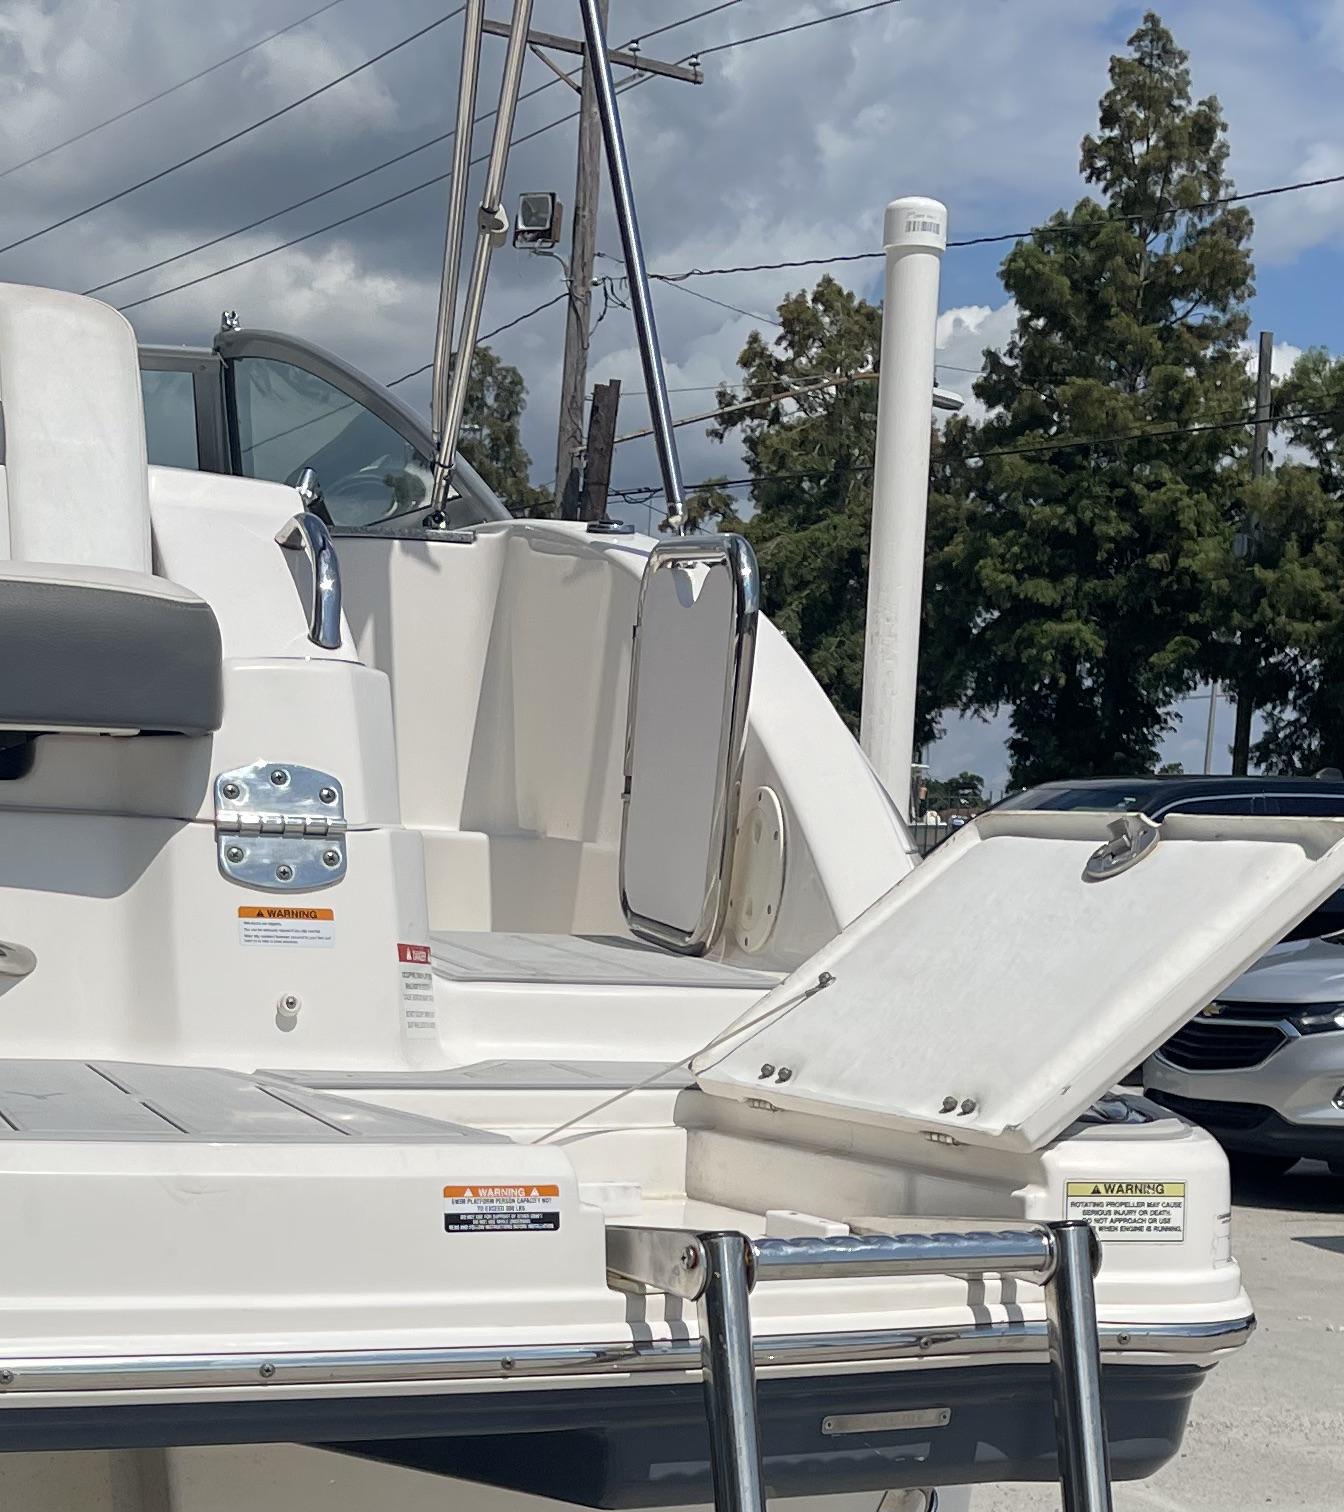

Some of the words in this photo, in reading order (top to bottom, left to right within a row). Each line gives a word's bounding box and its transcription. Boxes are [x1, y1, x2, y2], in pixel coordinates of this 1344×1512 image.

[267, 909, 318, 919] WARNING
[478, 1187, 525, 1197] WARNING
[1104, 1184, 1165, 1194] WARNING
